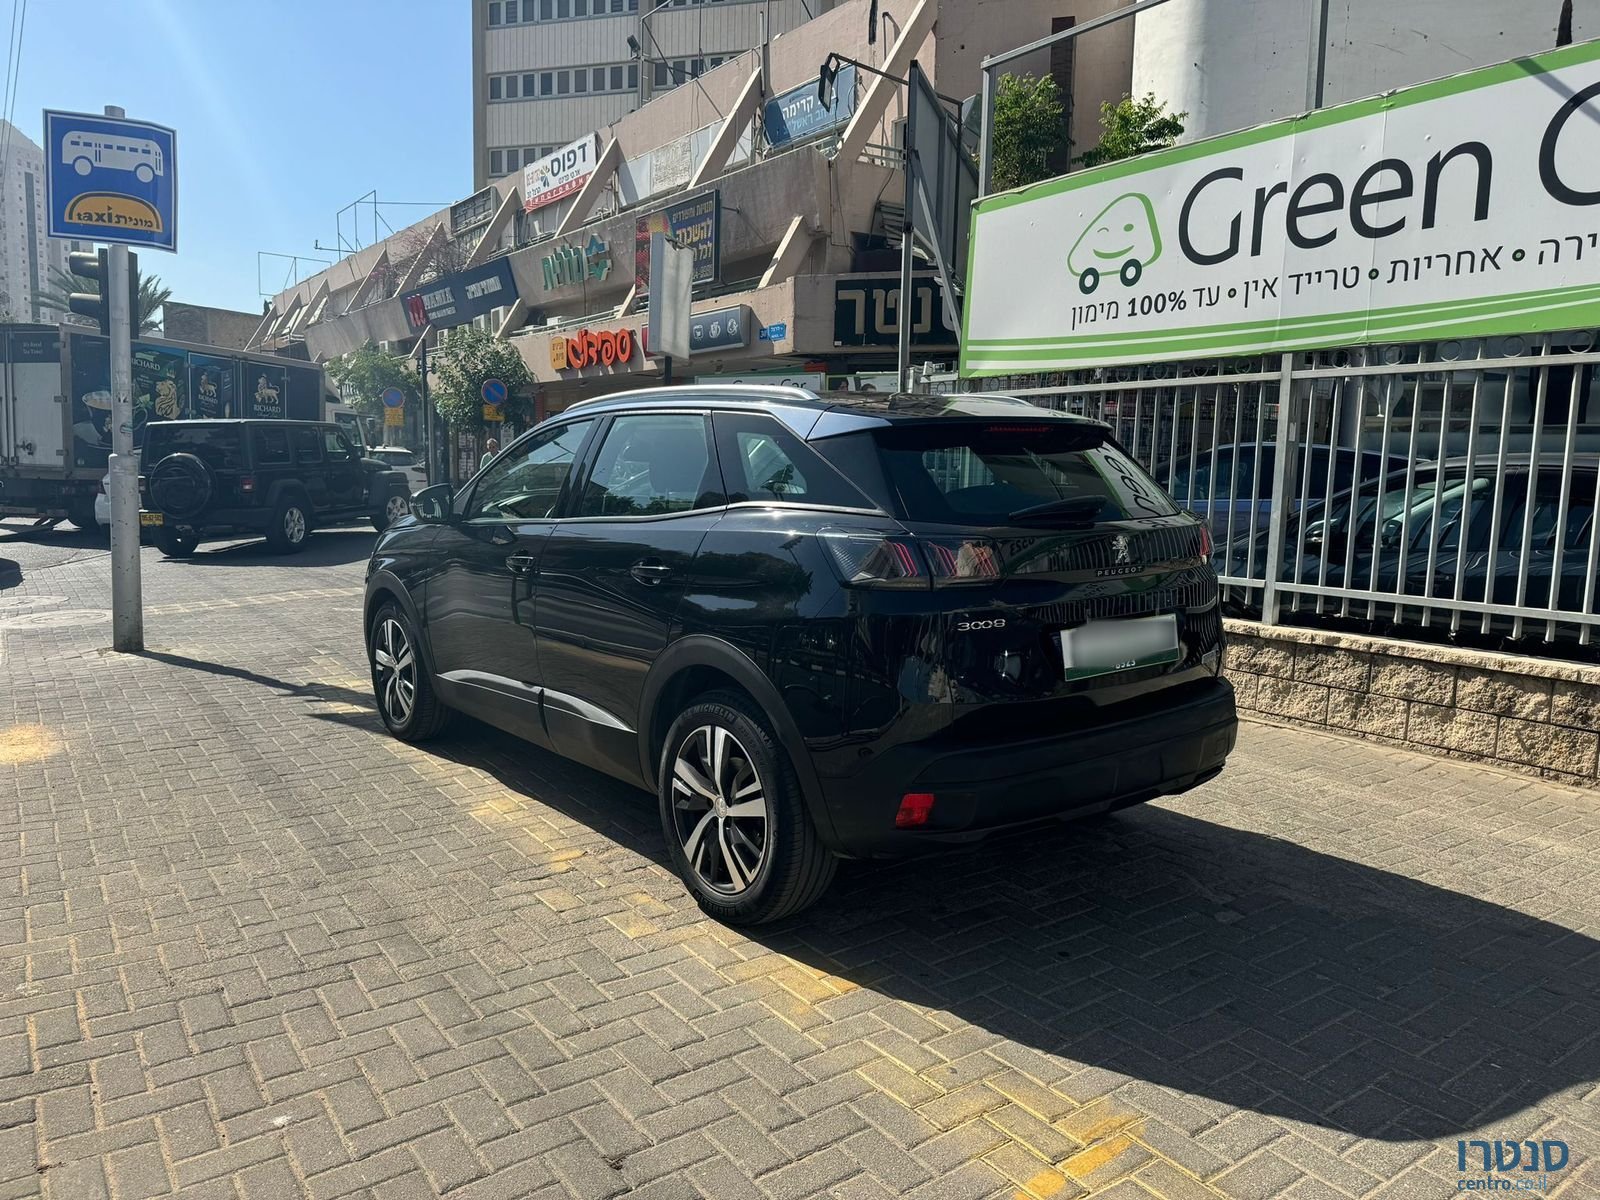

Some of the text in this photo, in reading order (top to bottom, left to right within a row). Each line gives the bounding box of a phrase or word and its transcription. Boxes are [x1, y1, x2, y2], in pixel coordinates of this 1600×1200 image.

[550, 142, 587, 177] דפוס
[77, 205, 113, 224] taxi
[1178, 141, 1493, 266] Green
[114, 214, 153, 228] מונית
[1386, 244, 1504, 284] אחריות
[1244, 276, 1279, 309] אין
[1288, 265, 1360, 295] טרייד
[1127, 289, 1188, 318] 100%
[1192, 285, 1221, 308] עד
[1070, 300, 1120, 331] מימון
[253, 404, 281, 414] RICHARD
[1097, 566, 1143, 577] PEUGEOT
[956, 617, 1008, 632] 3008
[693, 703, 735, 723] MICHELIN
